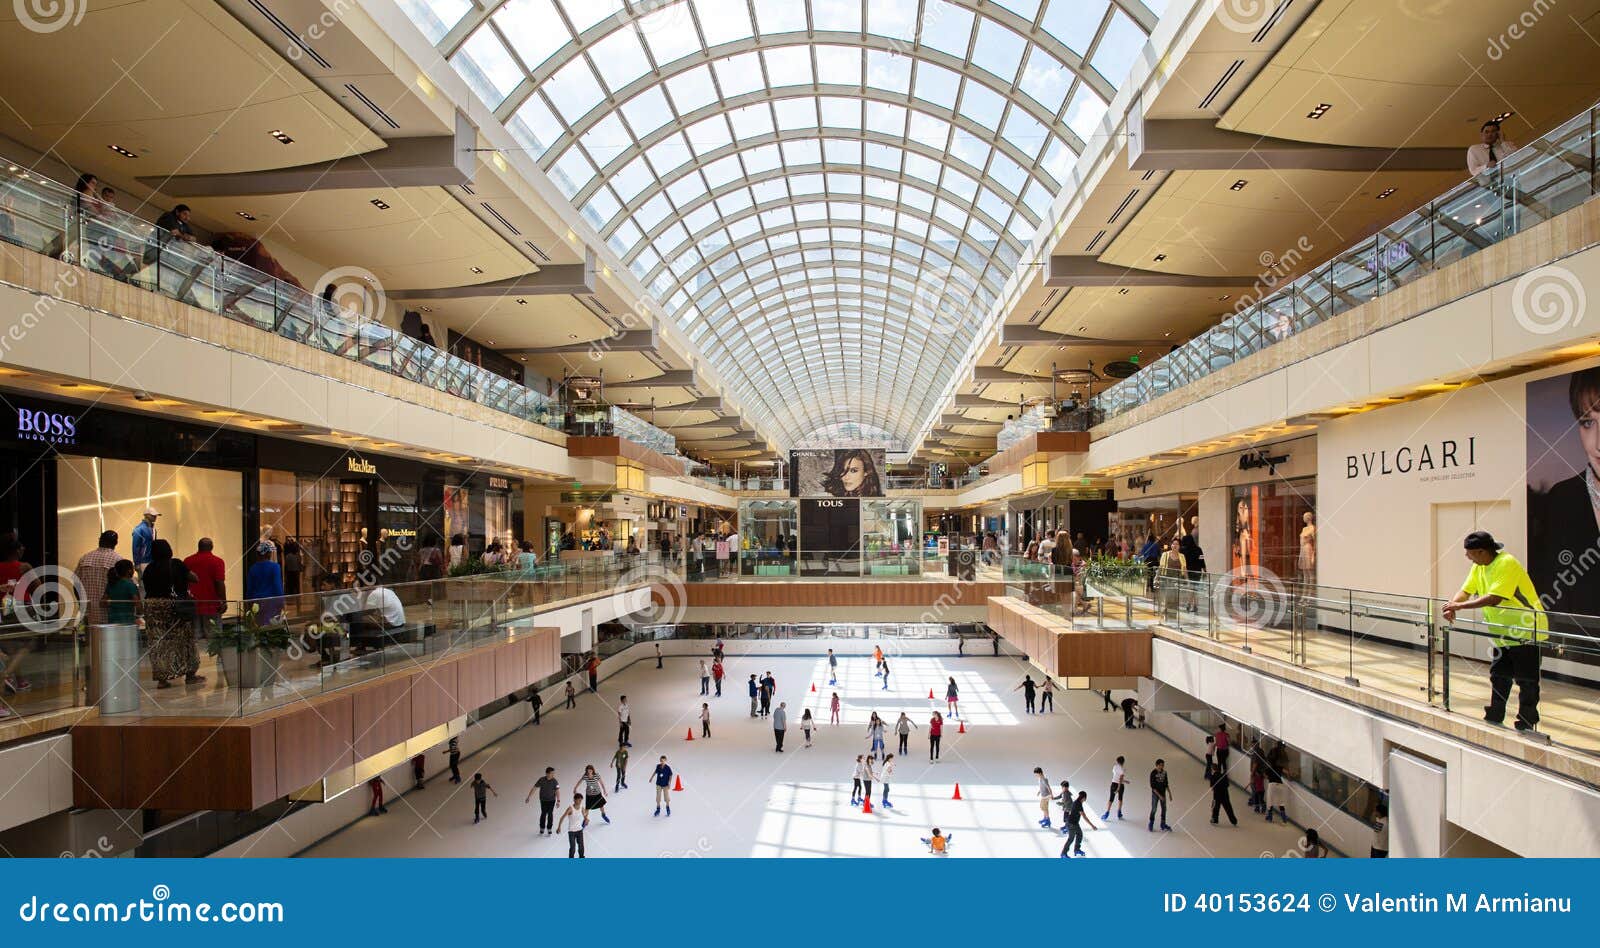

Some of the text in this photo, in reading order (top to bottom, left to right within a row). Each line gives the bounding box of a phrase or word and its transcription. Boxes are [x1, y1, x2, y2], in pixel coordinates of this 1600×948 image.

[18, 408, 76, 437] BOSS
[18, 433, 45, 441] HUGO
[1346, 436, 1475, 479] BVLGARI
[348, 457, 376, 474] MaxMara
[817, 500, 844, 508] TOUS
[387, 528, 416, 537] MaxMara
